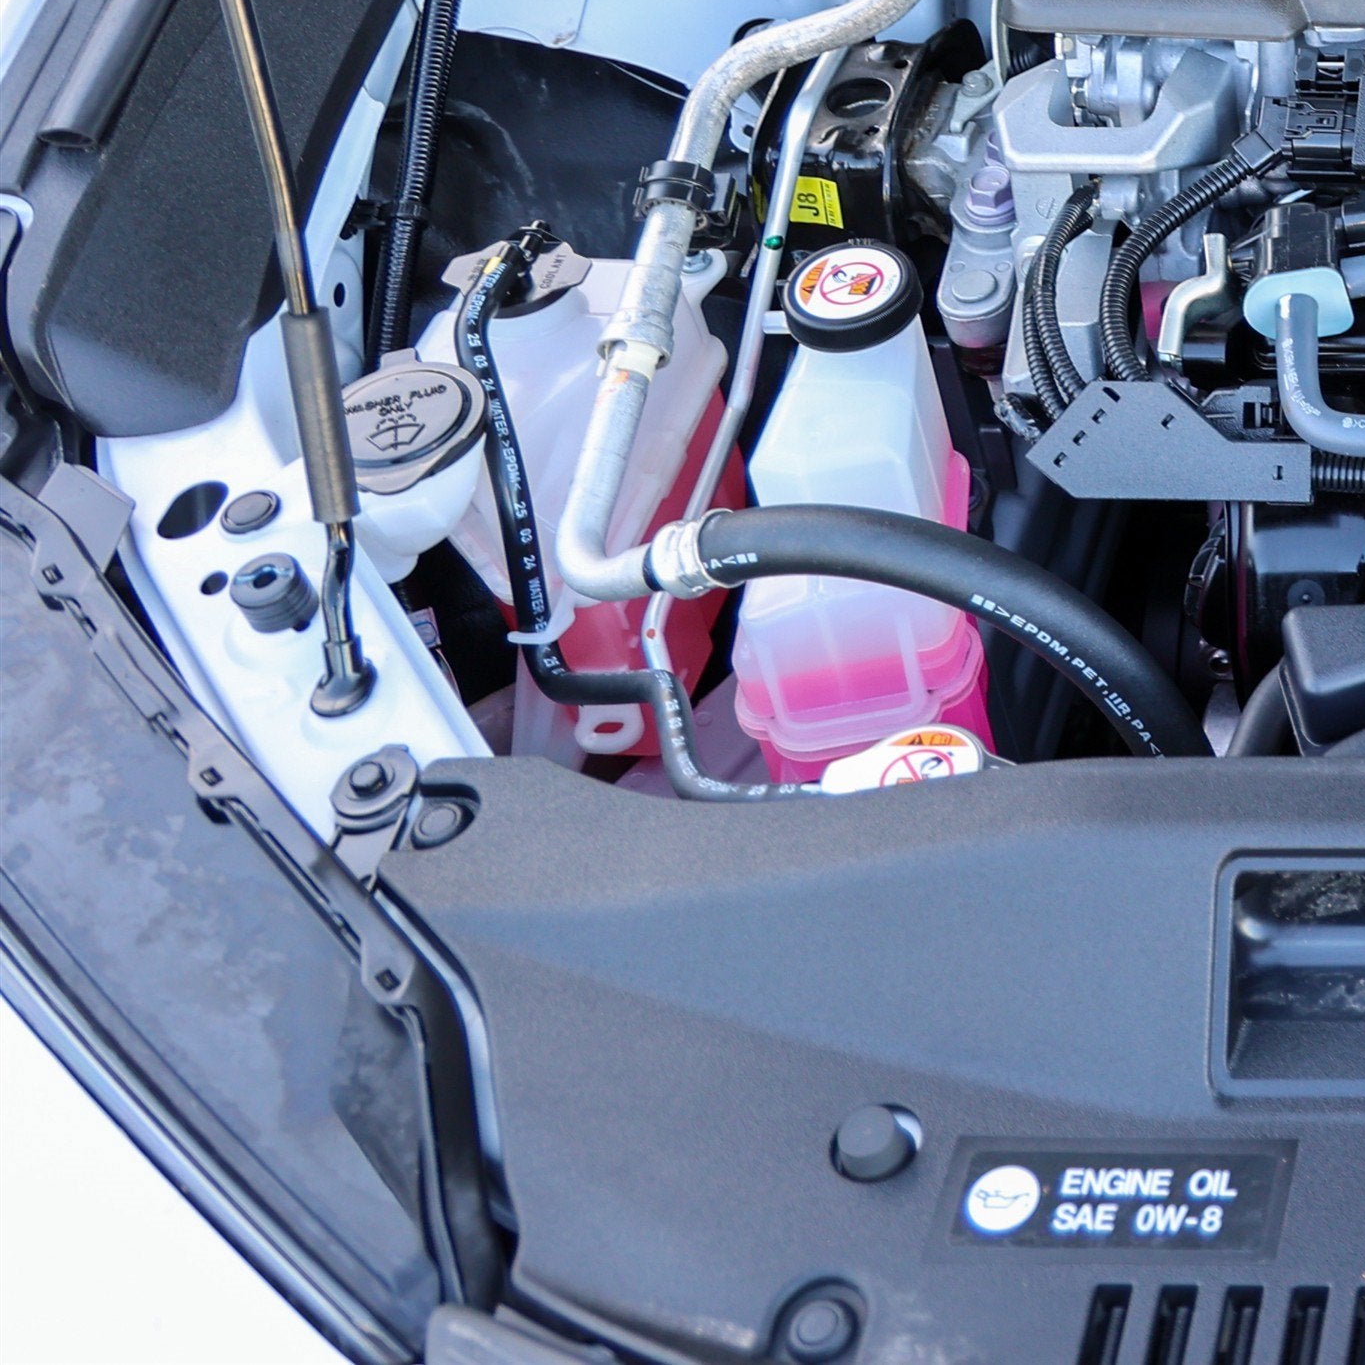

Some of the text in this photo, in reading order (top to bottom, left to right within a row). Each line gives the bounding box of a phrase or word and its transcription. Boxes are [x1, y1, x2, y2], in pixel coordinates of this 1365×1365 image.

[797, 192, 820, 217] J8
[539, 254, 567, 289] COOLANT
[1059, 1167, 1239, 1198] ENGINE OIL
[1052, 1202, 1224, 1233] SAE 0W-8
